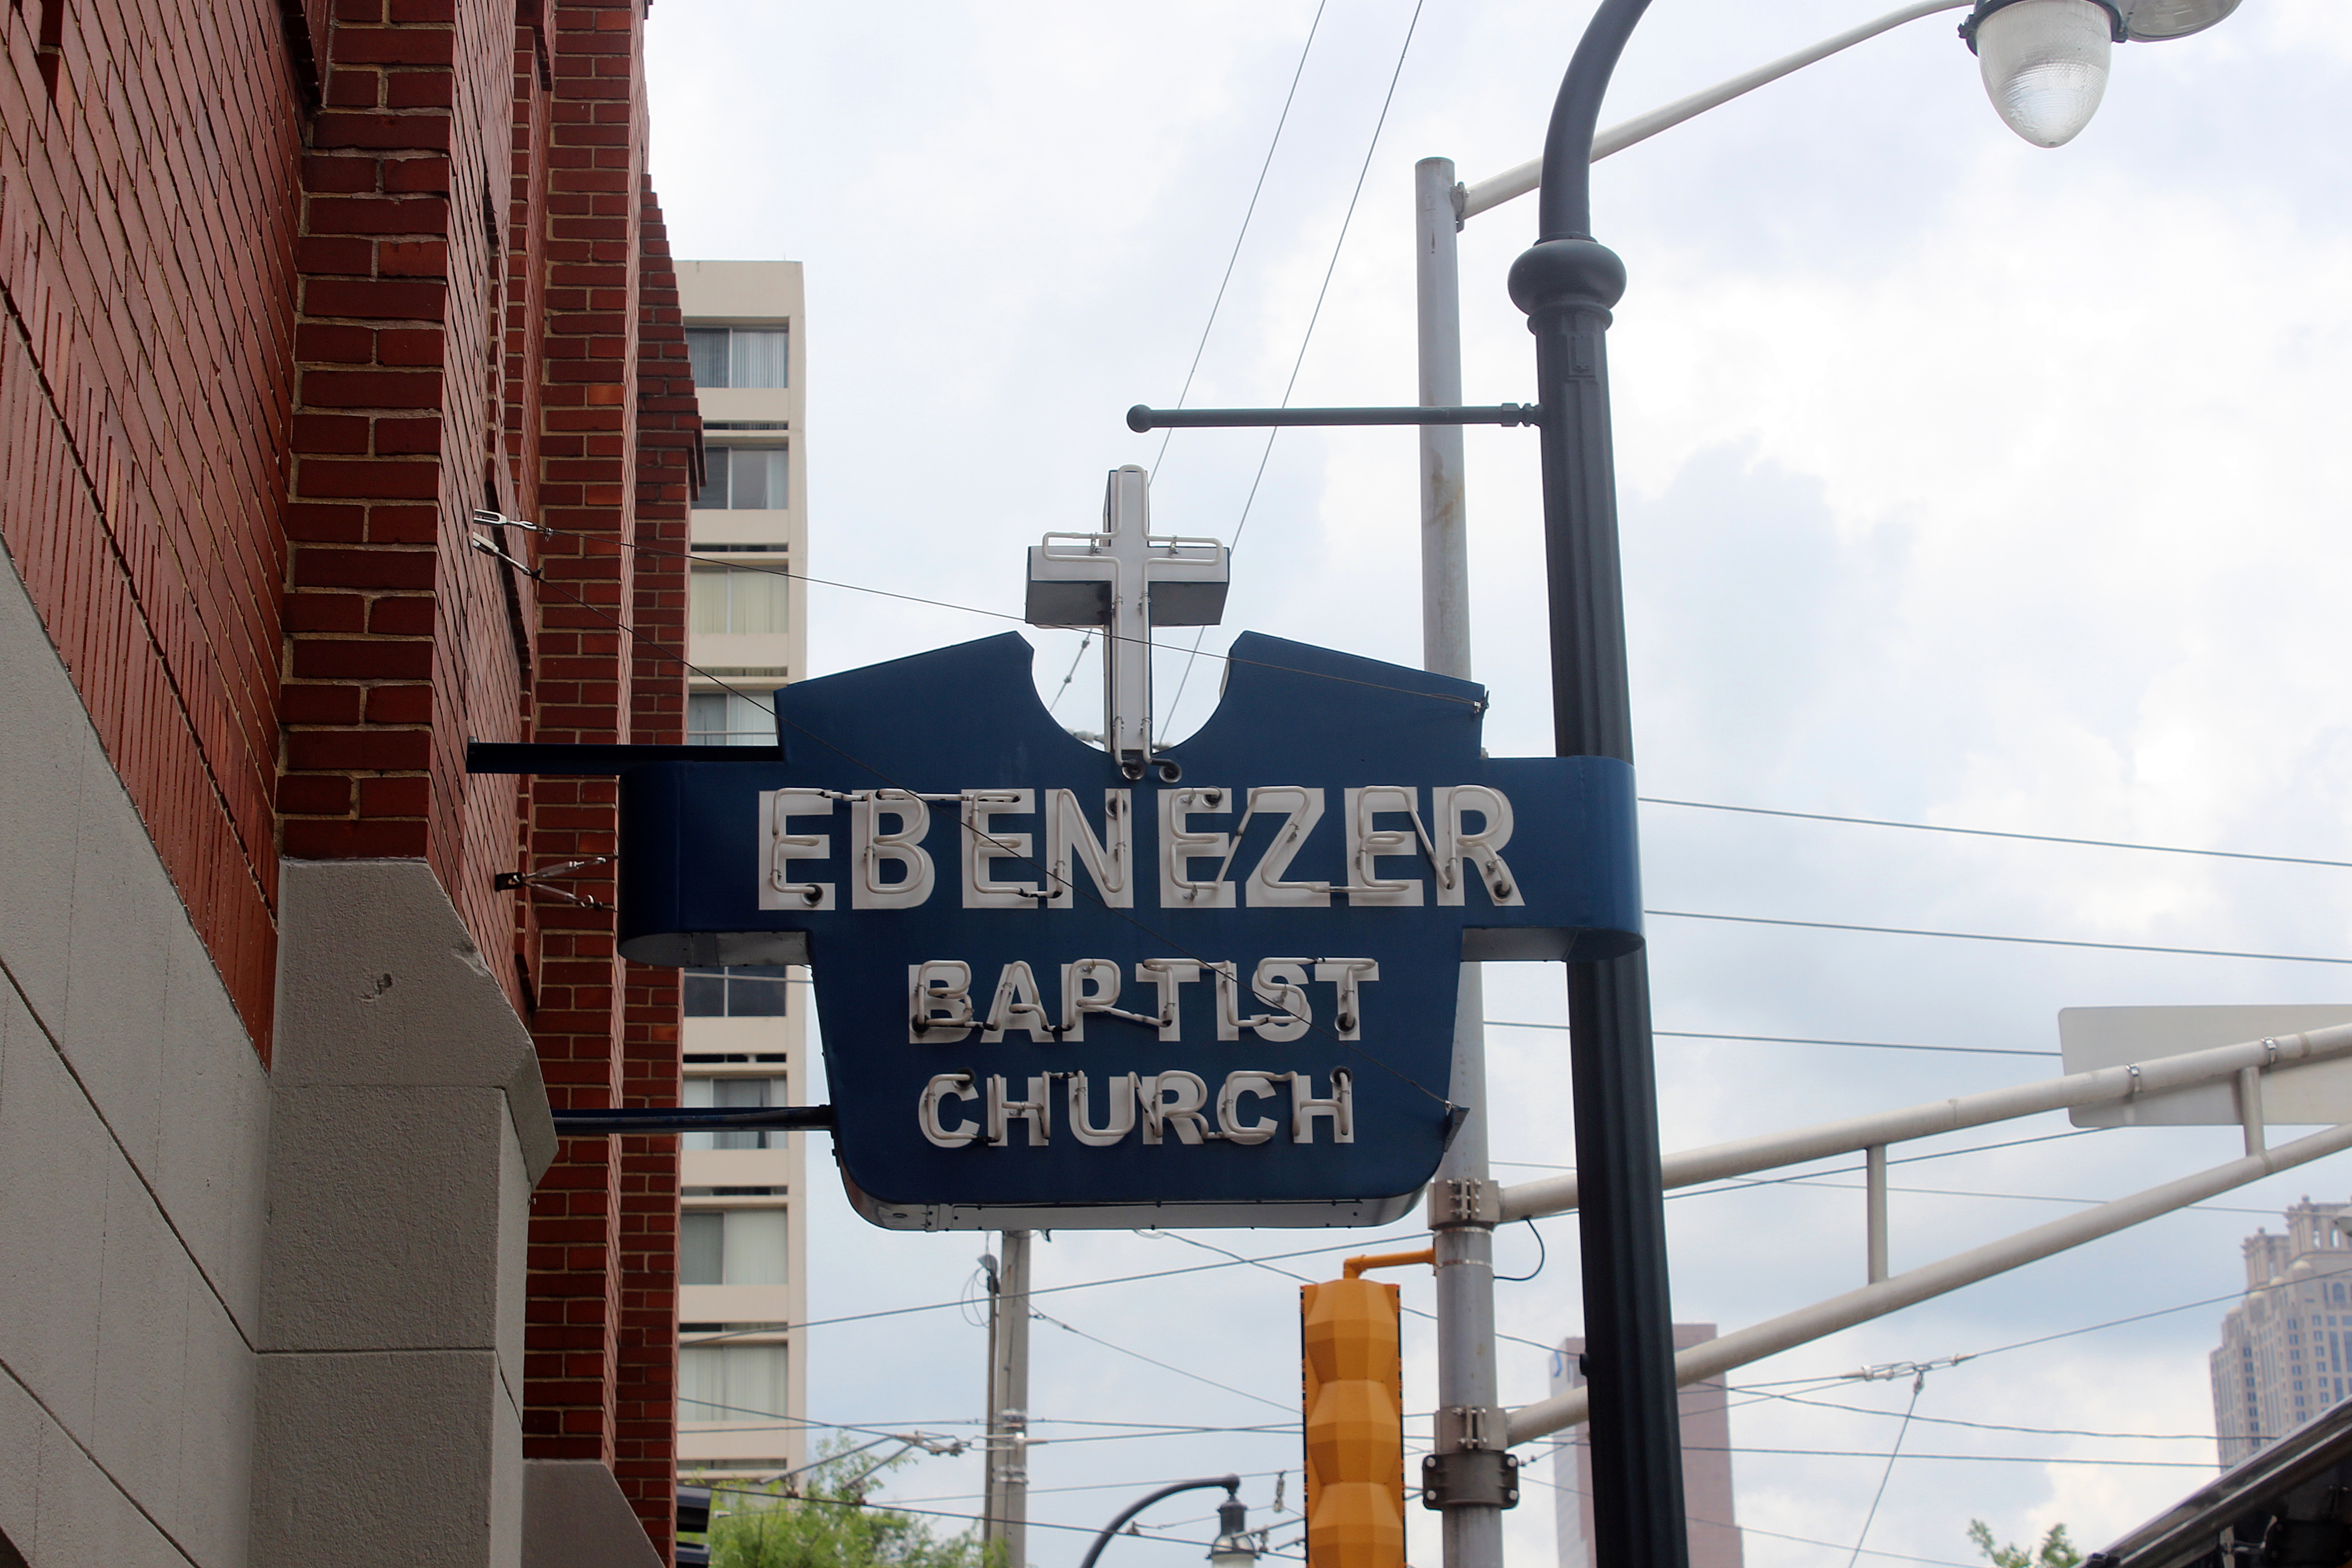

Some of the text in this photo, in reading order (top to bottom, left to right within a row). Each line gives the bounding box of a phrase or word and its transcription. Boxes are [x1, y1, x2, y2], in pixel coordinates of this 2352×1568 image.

[759, 786, 1525, 910] EBENEZER
[909, 959, 1379, 1043] BAPTIST
[918, 1072, 1354, 1147] CHURCH
